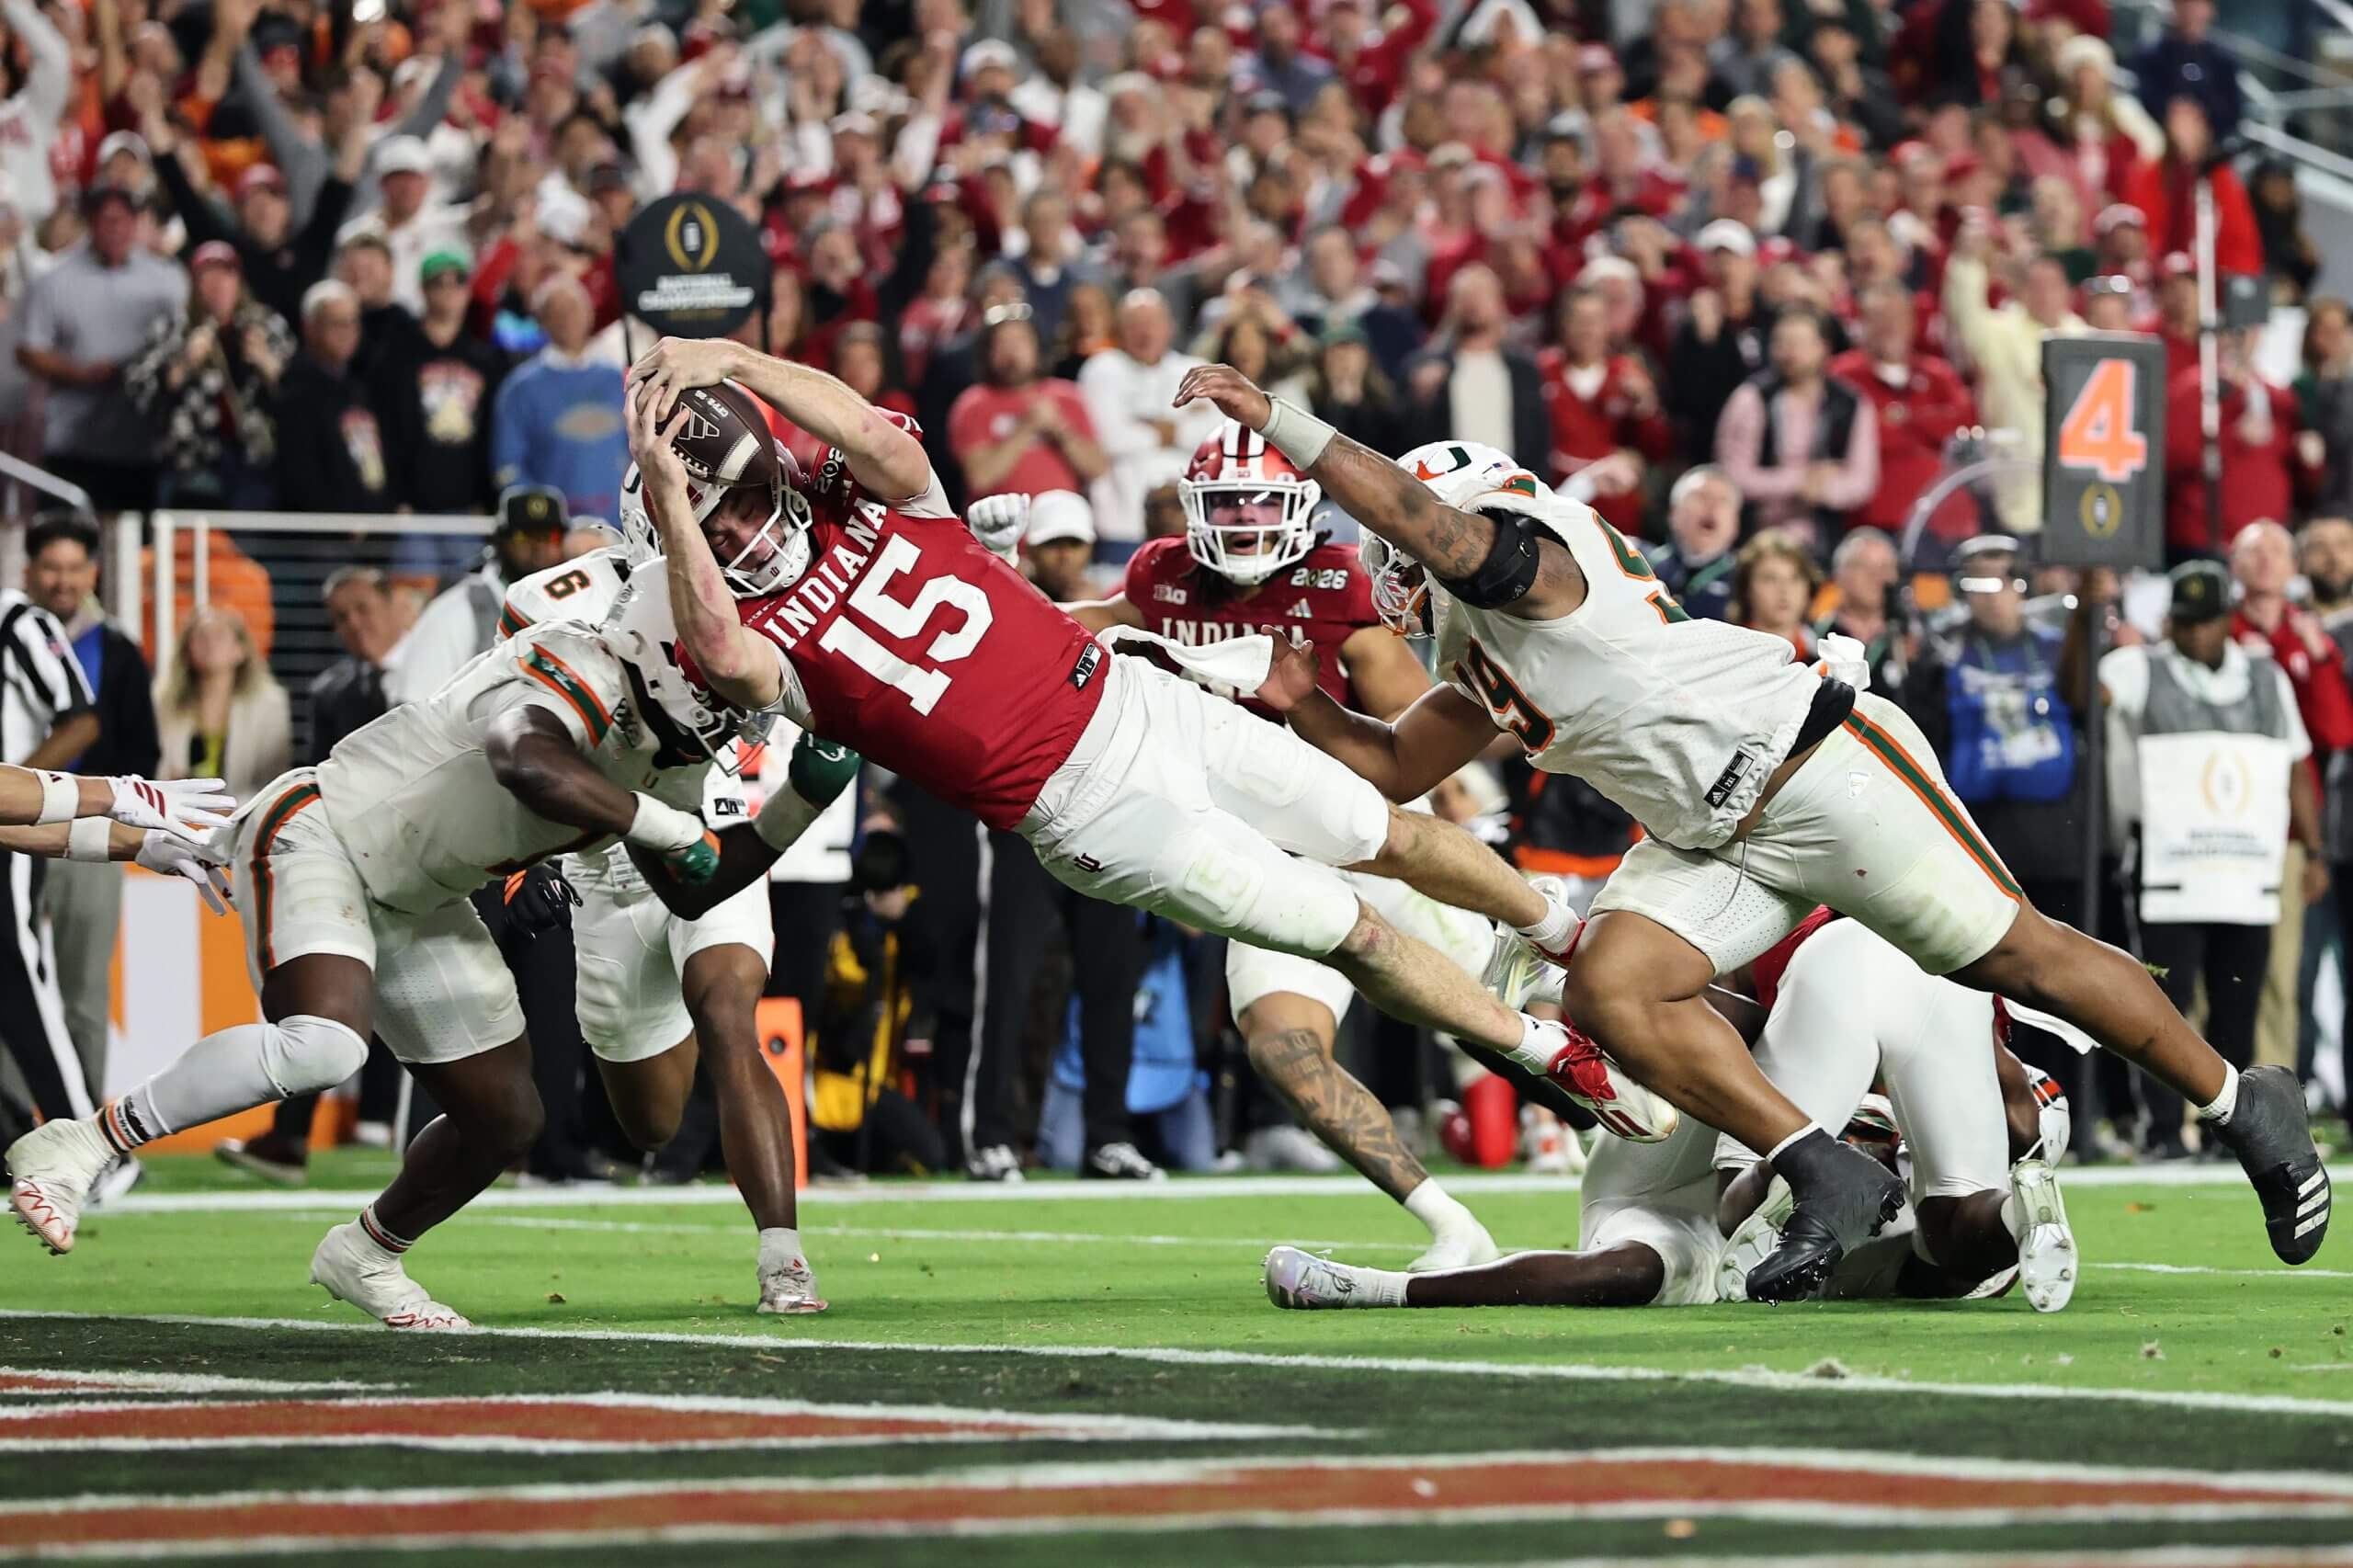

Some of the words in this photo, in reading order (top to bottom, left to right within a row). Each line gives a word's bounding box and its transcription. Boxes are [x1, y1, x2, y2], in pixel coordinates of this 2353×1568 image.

[2059, 358, 2147, 482] 4
[765, 497, 887, 649] INDIANA
[818, 532, 994, 717] 15
[1162, 617, 1305, 650] INDIA
